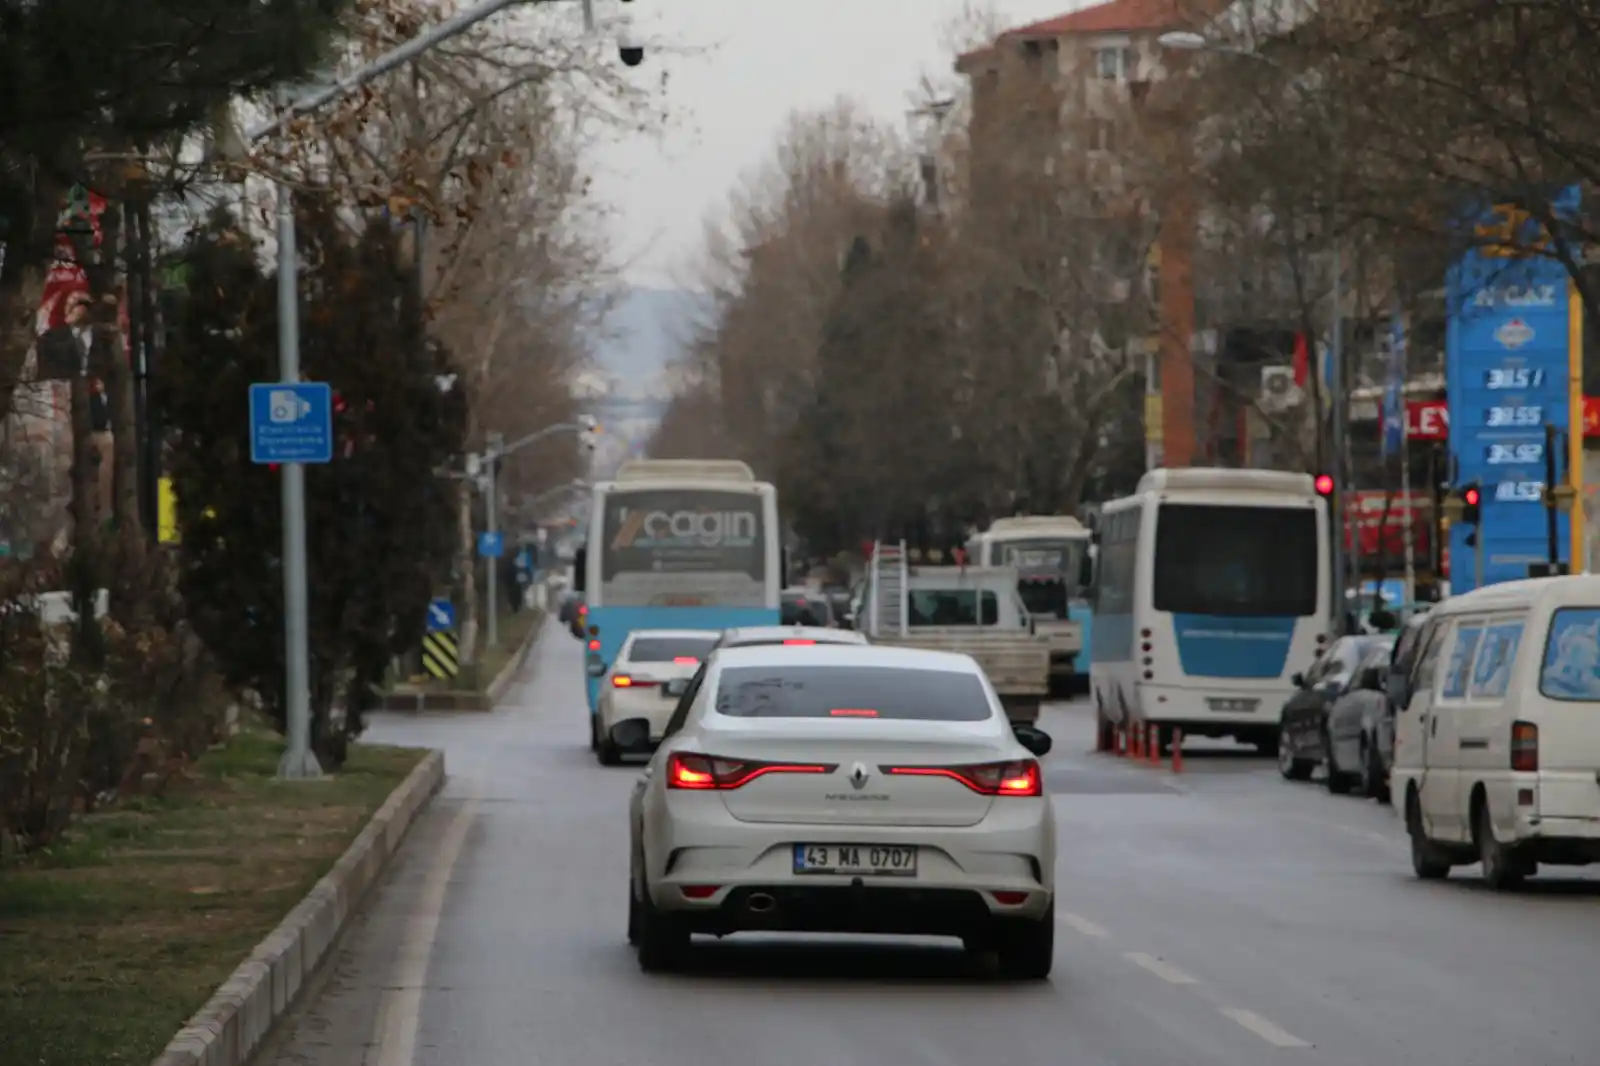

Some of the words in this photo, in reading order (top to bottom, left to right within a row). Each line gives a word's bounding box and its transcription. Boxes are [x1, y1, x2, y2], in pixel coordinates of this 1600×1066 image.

[1473, 284, 1555, 307] AGAZ
[807, 847, 828, 866] 43
[838, 847, 860, 867] MA
[870, 848, 912, 868] 0707
